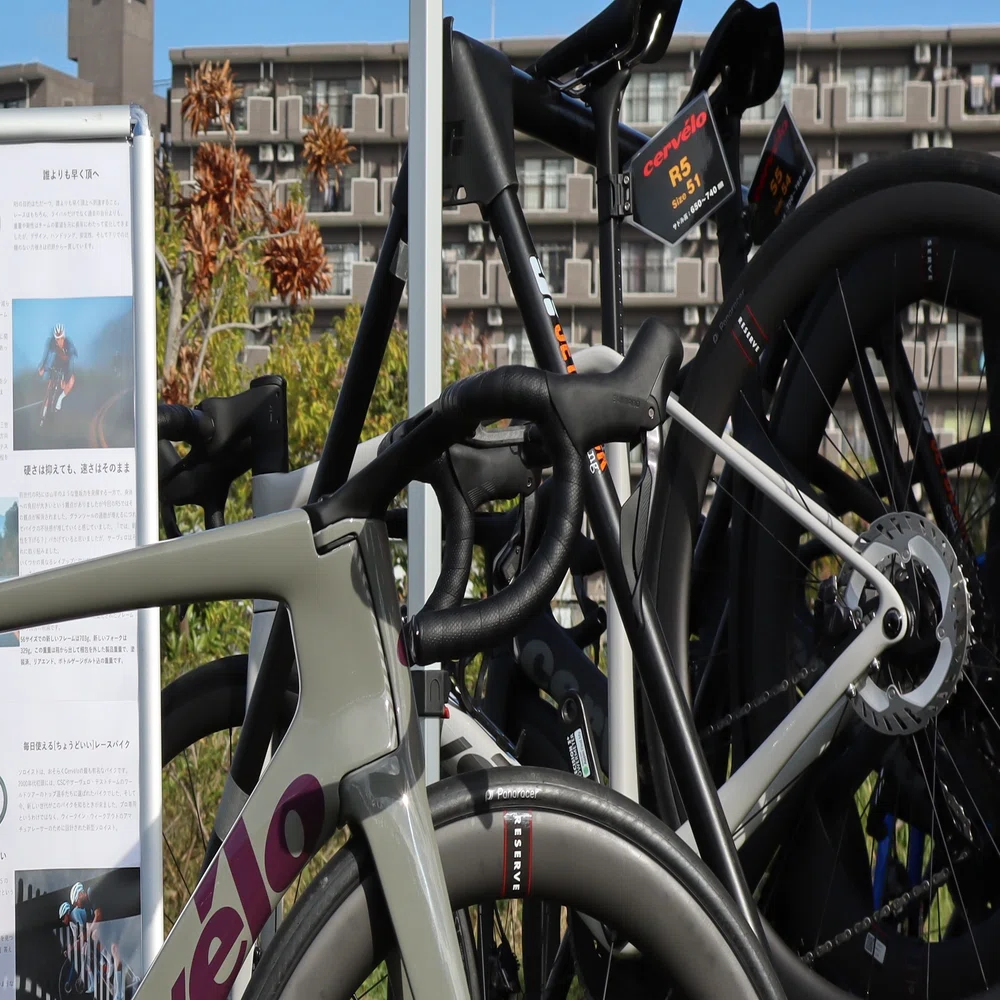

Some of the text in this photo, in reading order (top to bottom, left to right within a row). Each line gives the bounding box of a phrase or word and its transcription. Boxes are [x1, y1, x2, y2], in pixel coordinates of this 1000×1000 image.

[643, 111, 708, 177] cervélo
[42, 168, 100, 180] 誰よりも早く頂へ
[668, 155, 692, 188] R5
[671, 172, 702, 210] Size 51
[926, 239, 934, 281] SERVE
[737, 315, 761, 353] RESERVE
[23, 462, 130, 475] 硬さは抑えても、速さはそのまま
[497, 787, 539, 799] Panaracer
[512, 814, 522, 891] RESERVE
